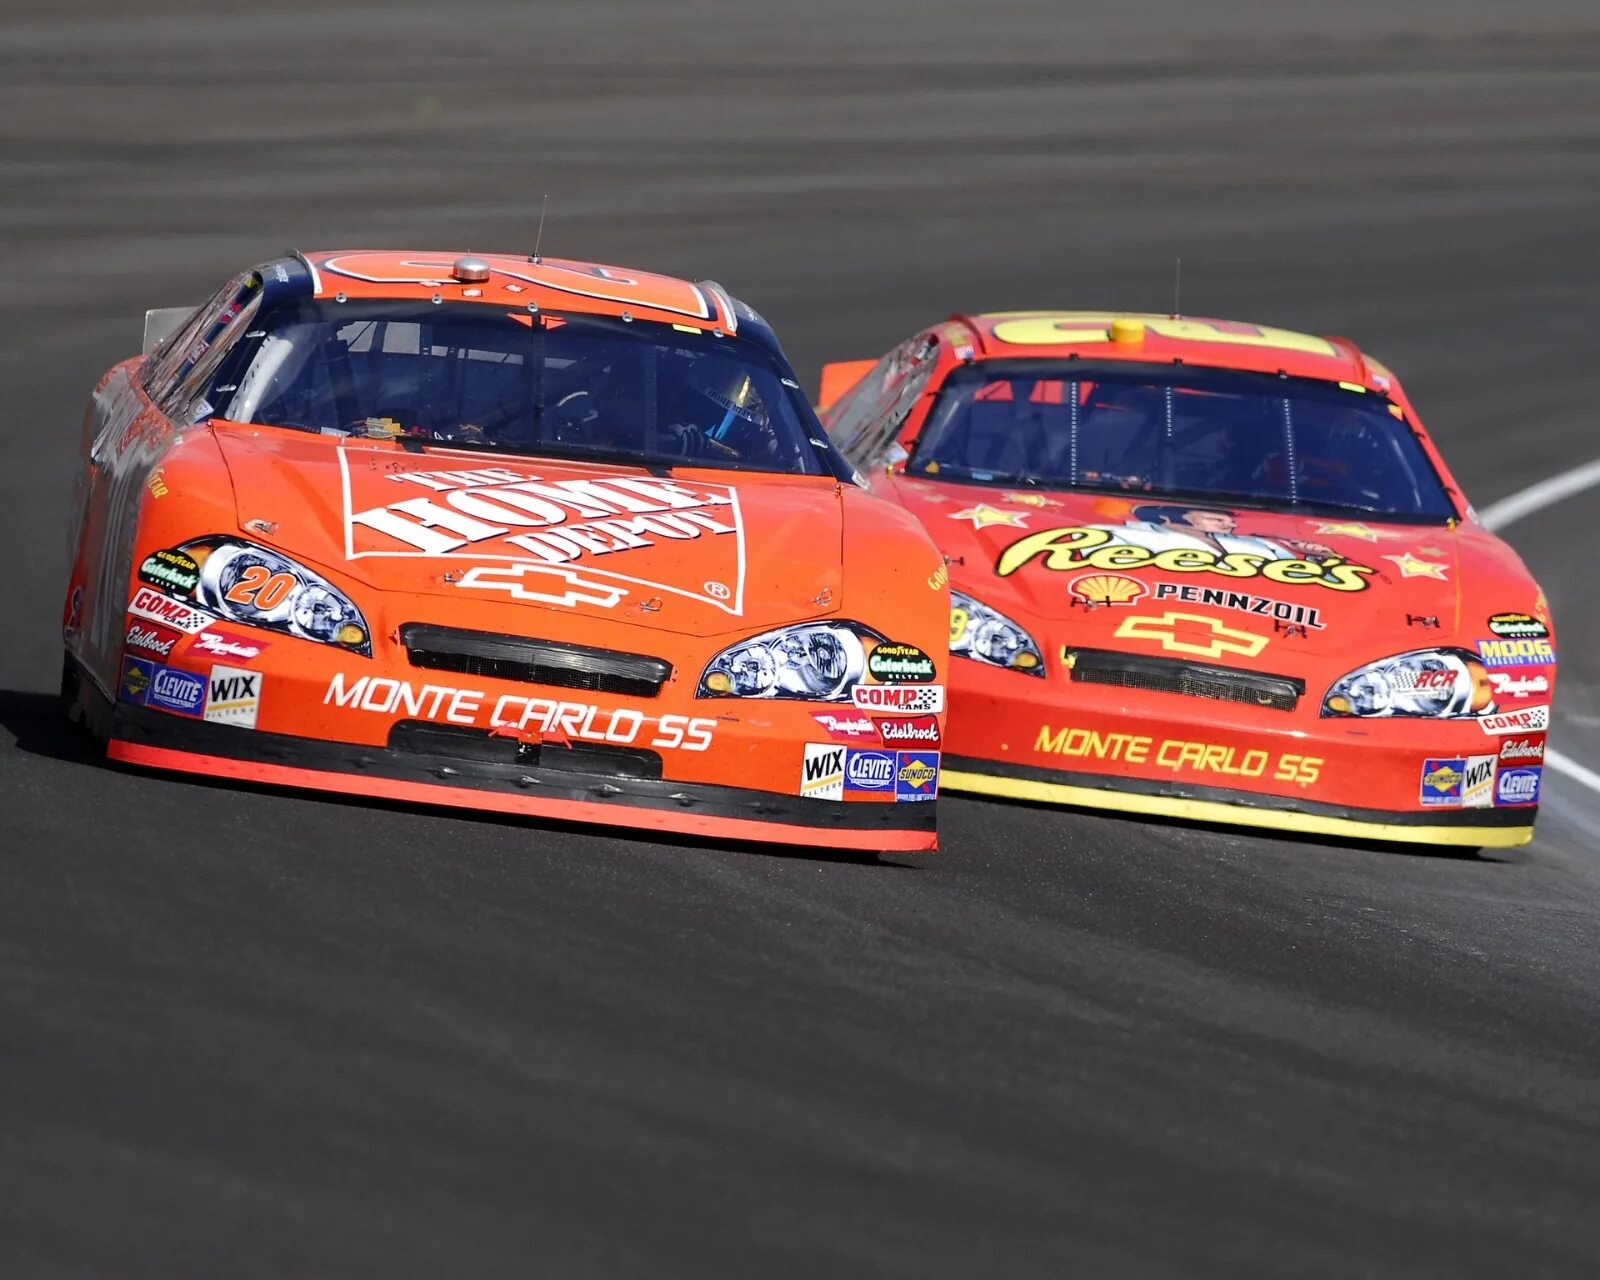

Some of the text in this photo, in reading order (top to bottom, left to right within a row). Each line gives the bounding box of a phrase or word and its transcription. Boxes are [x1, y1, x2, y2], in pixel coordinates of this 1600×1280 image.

[384, 468, 544, 492] THE
[351, 477, 734, 554] HOME
[502, 510, 738, 563] DEPOT
[994, 526, 1378, 592] Reese's
[224, 565, 298, 611] 20
[135, 591, 192, 619] COMP
[1156, 583, 1326, 629] PENNZOIL
[126, 625, 175, 656] Edelbrock
[877, 645, 919, 656] GOODYEAR
[1479, 640, 1552, 658] MOOG
[869, 655, 933, 673] Gatorback
[153, 669, 202, 702] CLEVITE
[211, 675, 256, 703] WIX
[1414, 669, 1459, 688] RCR
[855, 688, 918, 706] COMP
[323, 672, 718, 752] MONTE CARLO SS
[1483, 713, 1531, 729] COMP
[881, 722, 939, 741] Edelbrock
[805, 748, 844, 781] WIX
[850, 752, 893, 780] CLEVITE
[1034, 725, 1324, 783] MONTE CARLO SS
[899, 767, 936, 781] SUNOCO
[1466, 759, 1494, 788] WIX
